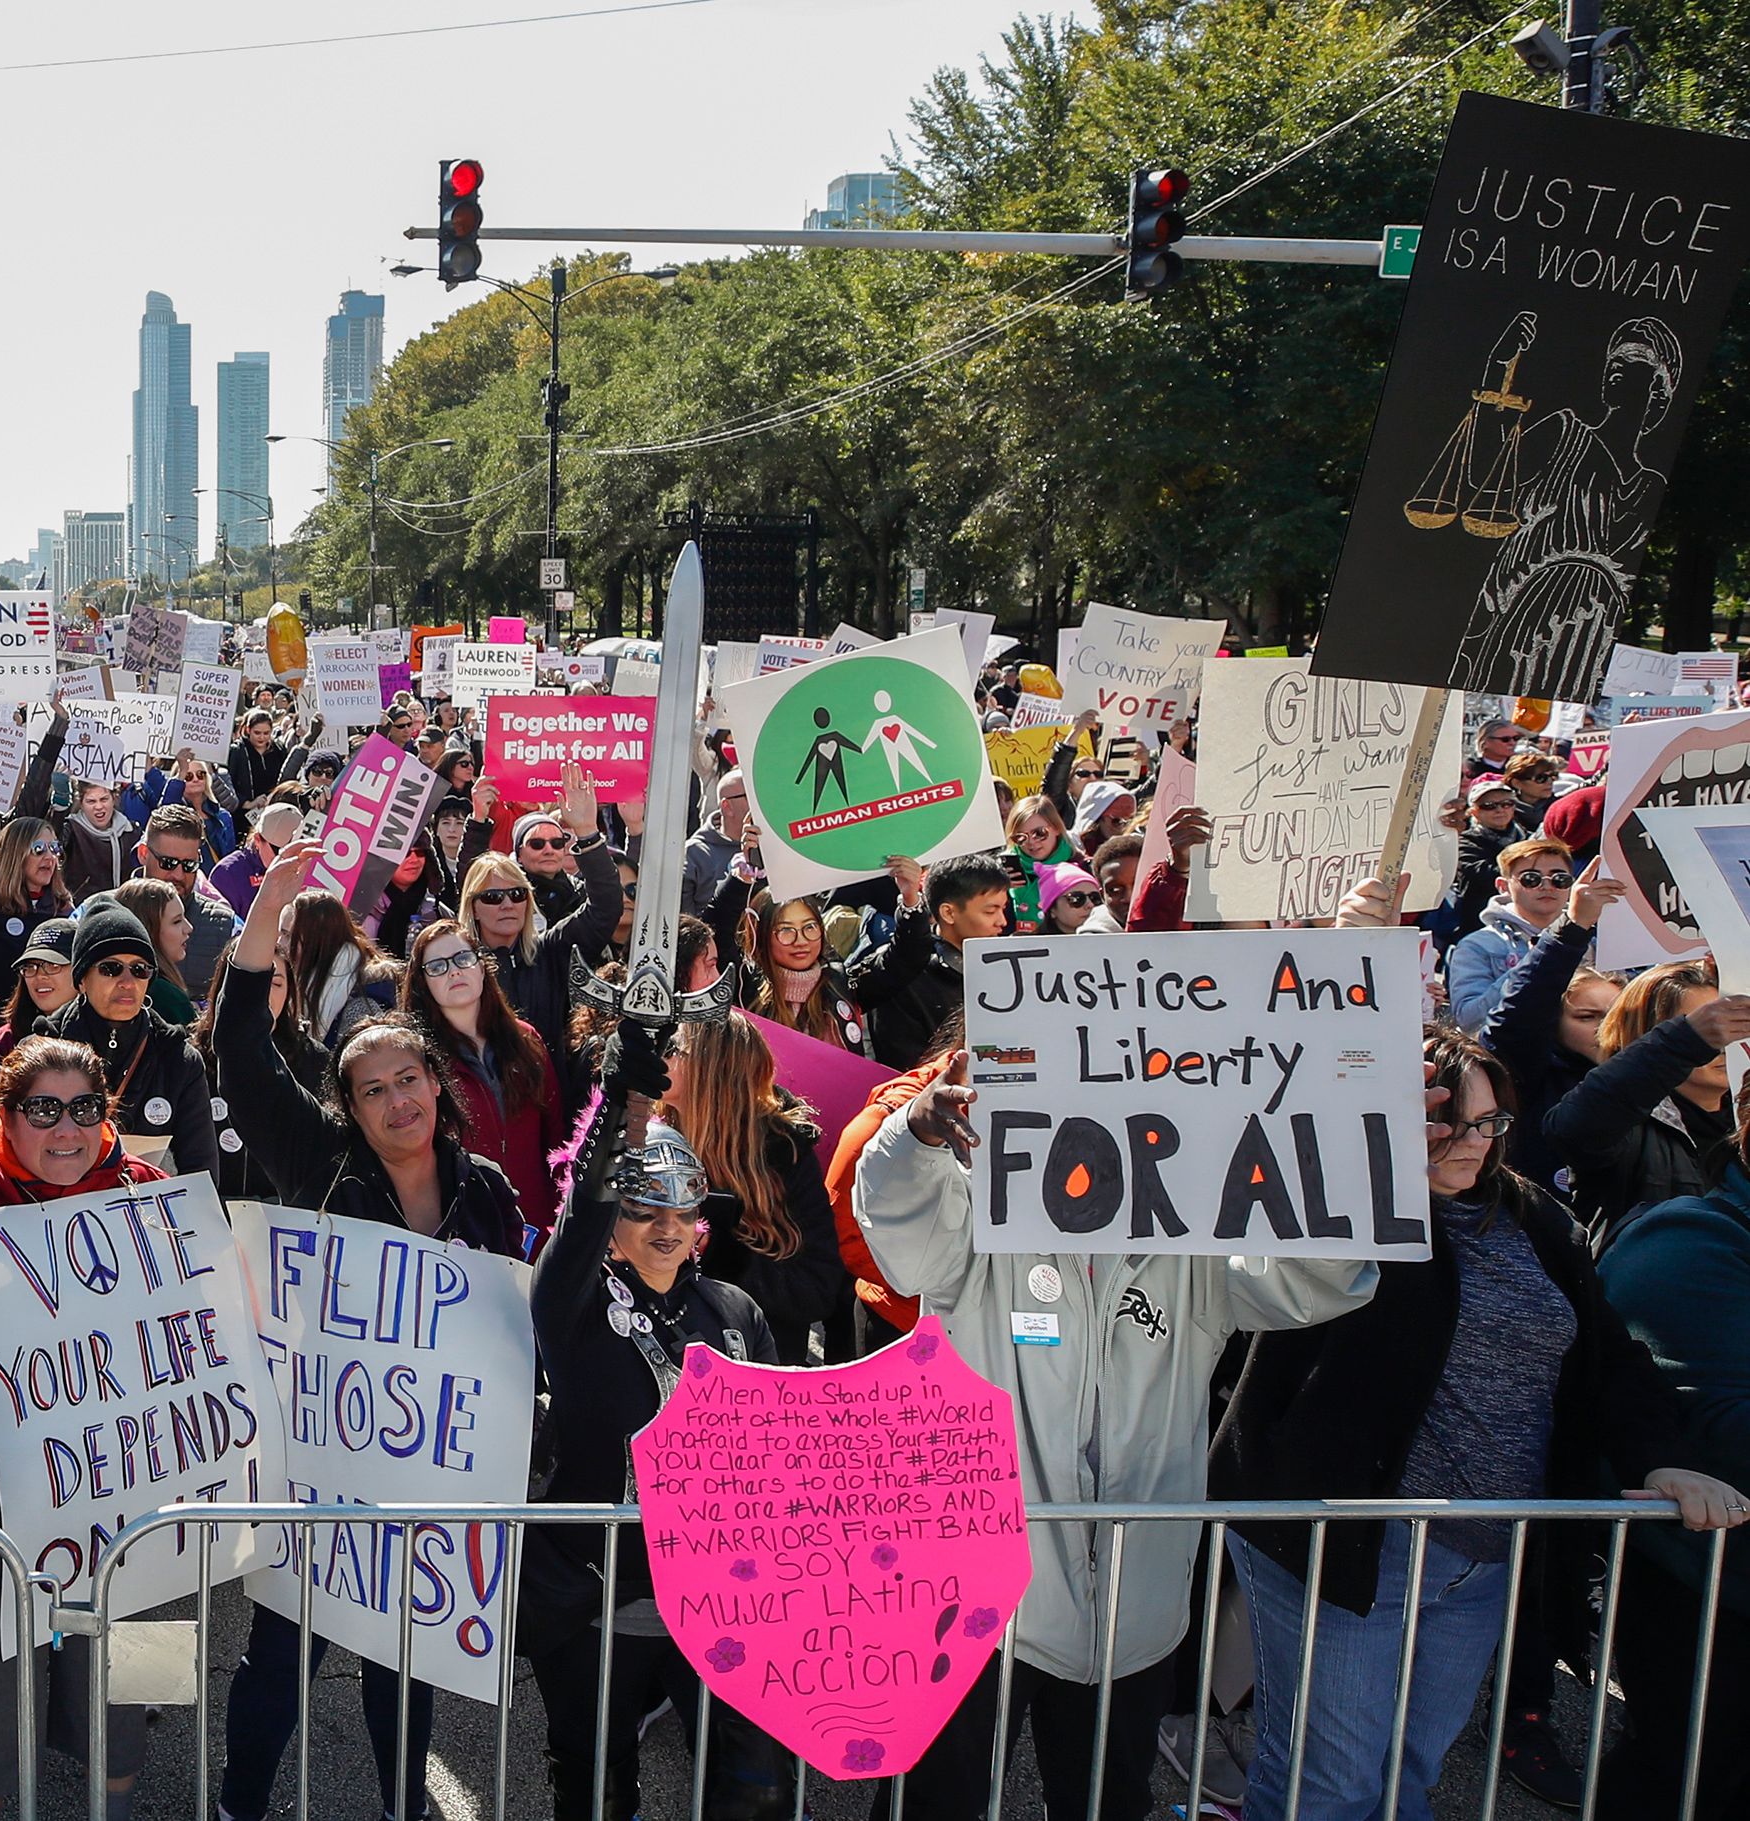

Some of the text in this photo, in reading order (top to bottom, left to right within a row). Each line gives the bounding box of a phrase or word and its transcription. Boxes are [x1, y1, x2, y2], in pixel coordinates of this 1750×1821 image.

[1457, 166, 1731, 255] JUSTICE
[1393, 236, 1403, 250] E
[1537, 242, 1699, 304] WOMAN
[543, 573, 562, 586] 30
[334, 648, 369, 660] ELECT
[457, 649, 518, 664] LAUREN
[1113, 619, 1211, 670] Take your
[318, 663, 377, 674] ARROGANT
[456, 667, 521, 678] UNDERWOOD
[762, 653, 788, 669] VOTE
[1076, 645, 1167, 689] COUNTRY
[61, 674, 88, 686] When
[191, 682, 231, 698] Callous
[193, 670, 230, 685] SUPER
[321, 679, 366, 692] WOMEN
[183, 706, 228, 720] RACIST
[184, 693, 232, 708] FASCIST
[325, 696, 377, 707] to OFFICE!
[1097, 687, 1179, 722] VOTE
[1264, 670, 1408, 746] GIRLS
[1648, 706, 1703, 717] LIKE YOUR
[31, 701, 144, 727] A Place
[191, 716, 218, 728] EXTRA
[498, 711, 649, 738] Together We
[14, 728, 24, 738] to
[94, 721, 123, 736] The
[180, 722, 225, 737] BRAGGA-
[182, 731, 221, 746] DOCIUS
[503, 738, 644, 766] Fight for All
[1005, 756, 1040, 778] hath
[1317, 778, 1349, 803] HAVE
[376, 771, 431, 851] WIN.
[796, 784, 956, 835] HUMAN RIGHTS
[306, 754, 399, 901] VOTE.
[978, 947, 1380, 1014] Justice And
[1075, 1024, 1305, 1115] Liberty
[989, 1110, 1428, 1245] FOR ALL
[269, 1226, 470, 1351] FLIP
[135, 1308, 231, 1392] LIFE
[686, 1375, 766, 1406] When
[774, 1380, 814, 1406] You
[920, 1374, 943, 1399] in
[685, 1407, 822, 1428] Front of the
[42, 1382, 259, 1509] DEPENDS
[652, 1426, 748, 1451] Unafraid
[757, 1430, 791, 1451] to
[784, 1448, 904, 1470] an easier
[650, 1468, 914, 1495] for others to do the
[734, 1489, 997, 1520] are AND
[652, 1496, 1024, 1559] #WARRIORS BACK!
[774, 1544, 857, 1582] SOY
[802, 1624, 853, 1653] en
